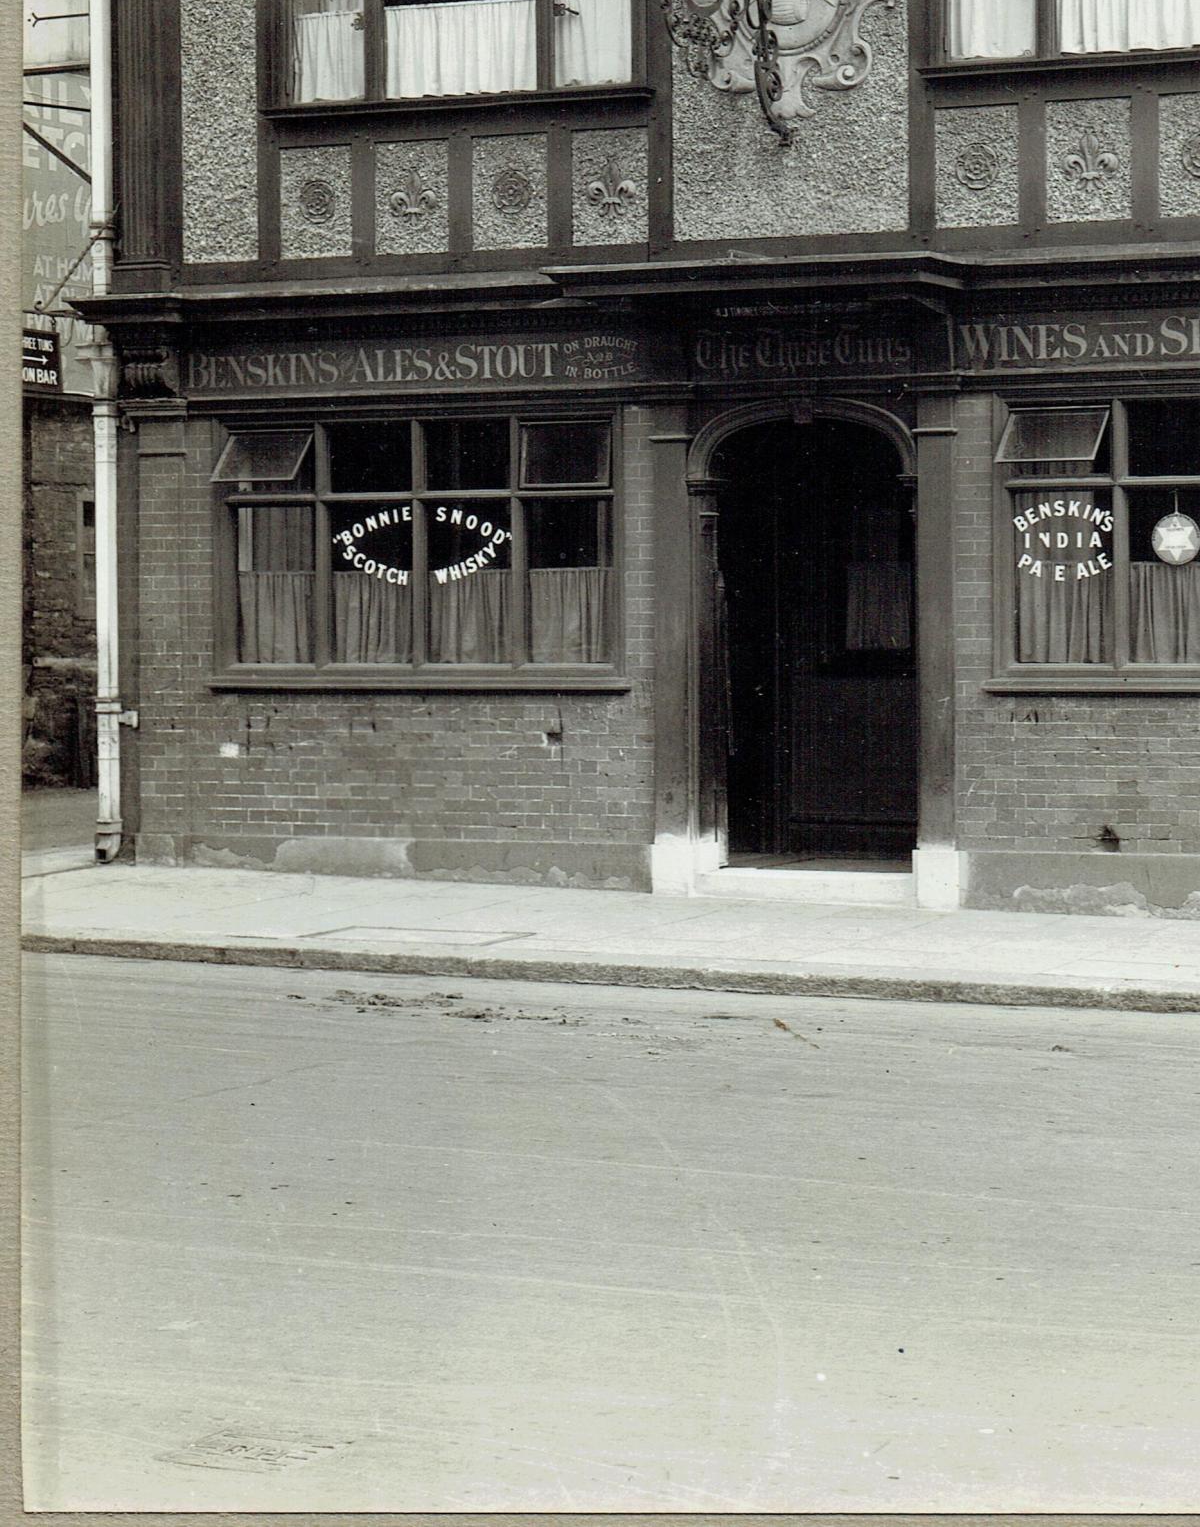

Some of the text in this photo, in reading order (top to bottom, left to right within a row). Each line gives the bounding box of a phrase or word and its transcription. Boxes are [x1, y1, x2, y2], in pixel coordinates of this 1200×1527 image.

[33, 254, 93, 282] AT HOM
[563, 336, 639, 354] ON DRAUGHT
[960, 324, 1088, 361] WINES
[1091, 333, 1155, 357] AND
[36, 368, 58, 385] BAR
[565, 365, 579, 378] IN
[1013, 500, 1114, 532] BENSKIN'S
[1024, 532, 1102, 549] INDIA
[342, 542, 497, 585] SCOTCH WHISKY
[1077, 553, 1113, 580] ALE
